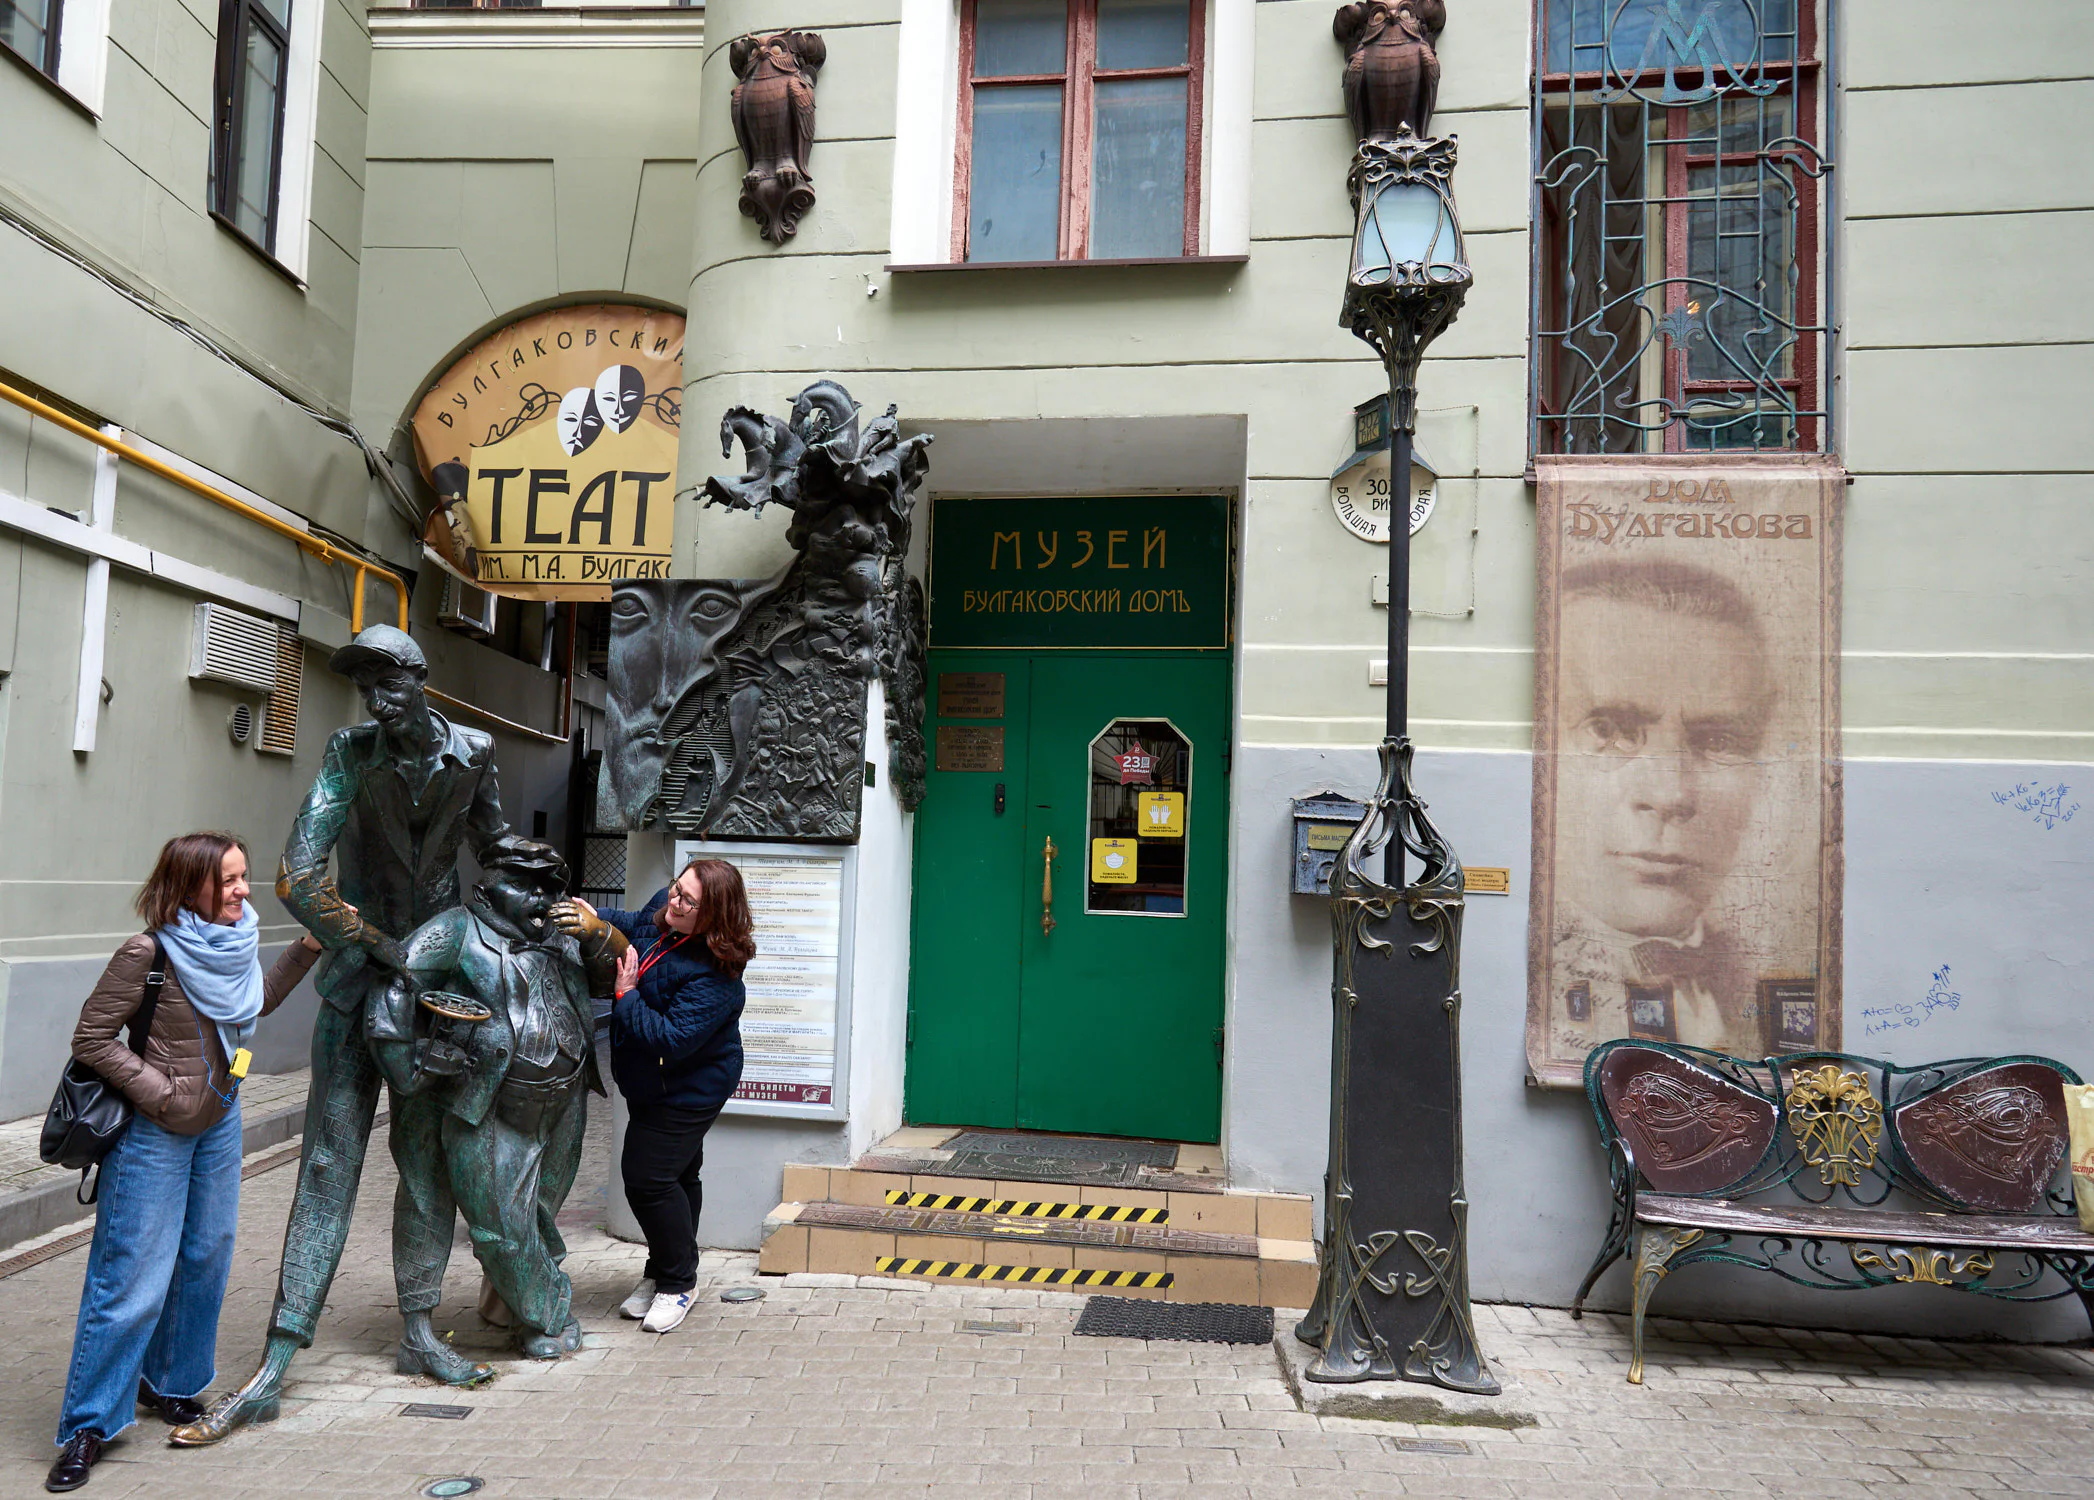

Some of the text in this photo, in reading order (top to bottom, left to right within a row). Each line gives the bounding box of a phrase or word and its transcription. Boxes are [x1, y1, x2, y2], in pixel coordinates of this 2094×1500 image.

[1366, 478, 1391, 496] 30
[1643, 474, 1736, 503] Дом
[477, 467, 673, 548] ТЕАТ
[1336, 486, 1431, 536] БОЛЬШАЯ ОВАЯ
[1372, 498, 1391, 511] БИ
[1566, 503, 1813, 546] Булгакова
[990, 526, 1167, 570] МУЗЕЙ
[481, 556, 509, 579] ИМ.
[521, 554, 565, 579] М.А.
[963, 587, 1191, 613] БУЛГАКОВСКИЙ ДОМЪ
[1122, 755, 1141, 768] 23
[736, 1081, 796, 1093] АЙТЕ БИЛЕТЫ
[749, 1091, 777, 1100] МУЗЕЯ
